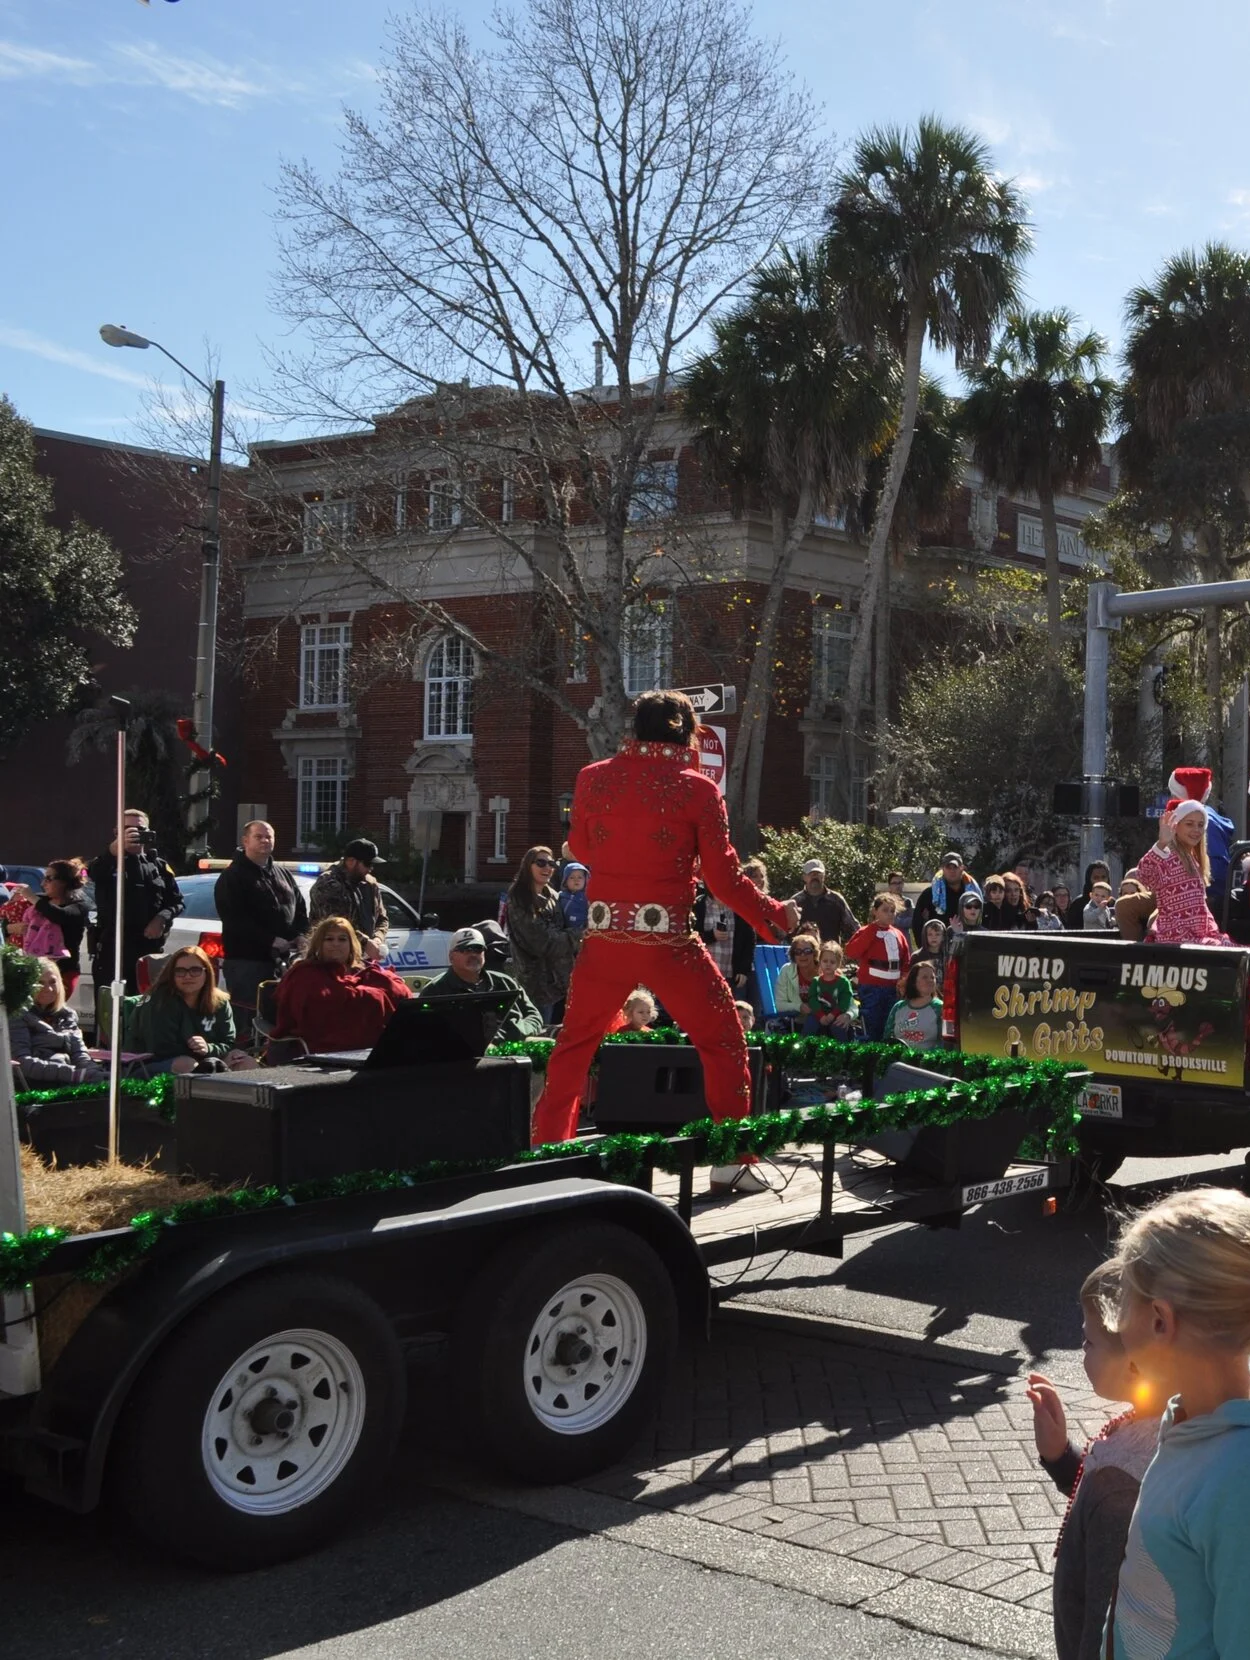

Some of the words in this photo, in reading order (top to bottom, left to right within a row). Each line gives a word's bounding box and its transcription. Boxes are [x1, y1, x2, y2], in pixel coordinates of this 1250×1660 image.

[703, 739, 718, 751] NOT
[699, 768, 716, 780] TER
[379, 951, 428, 966] LICE
[997, 955, 1064, 980] WORLD
[1120, 963, 1208, 991] FAMOUS
[992, 981, 1096, 1021] Shrimp
[1004, 1025, 1026, 1057] &
[1032, 1021, 1105, 1056] Grits
[1105, 1049, 1158, 1066] DOWNTOWN
[1161, 1054, 1227, 1073] BROOKSVILLE
[966, 1173, 1044, 1202] 866-438-2556
